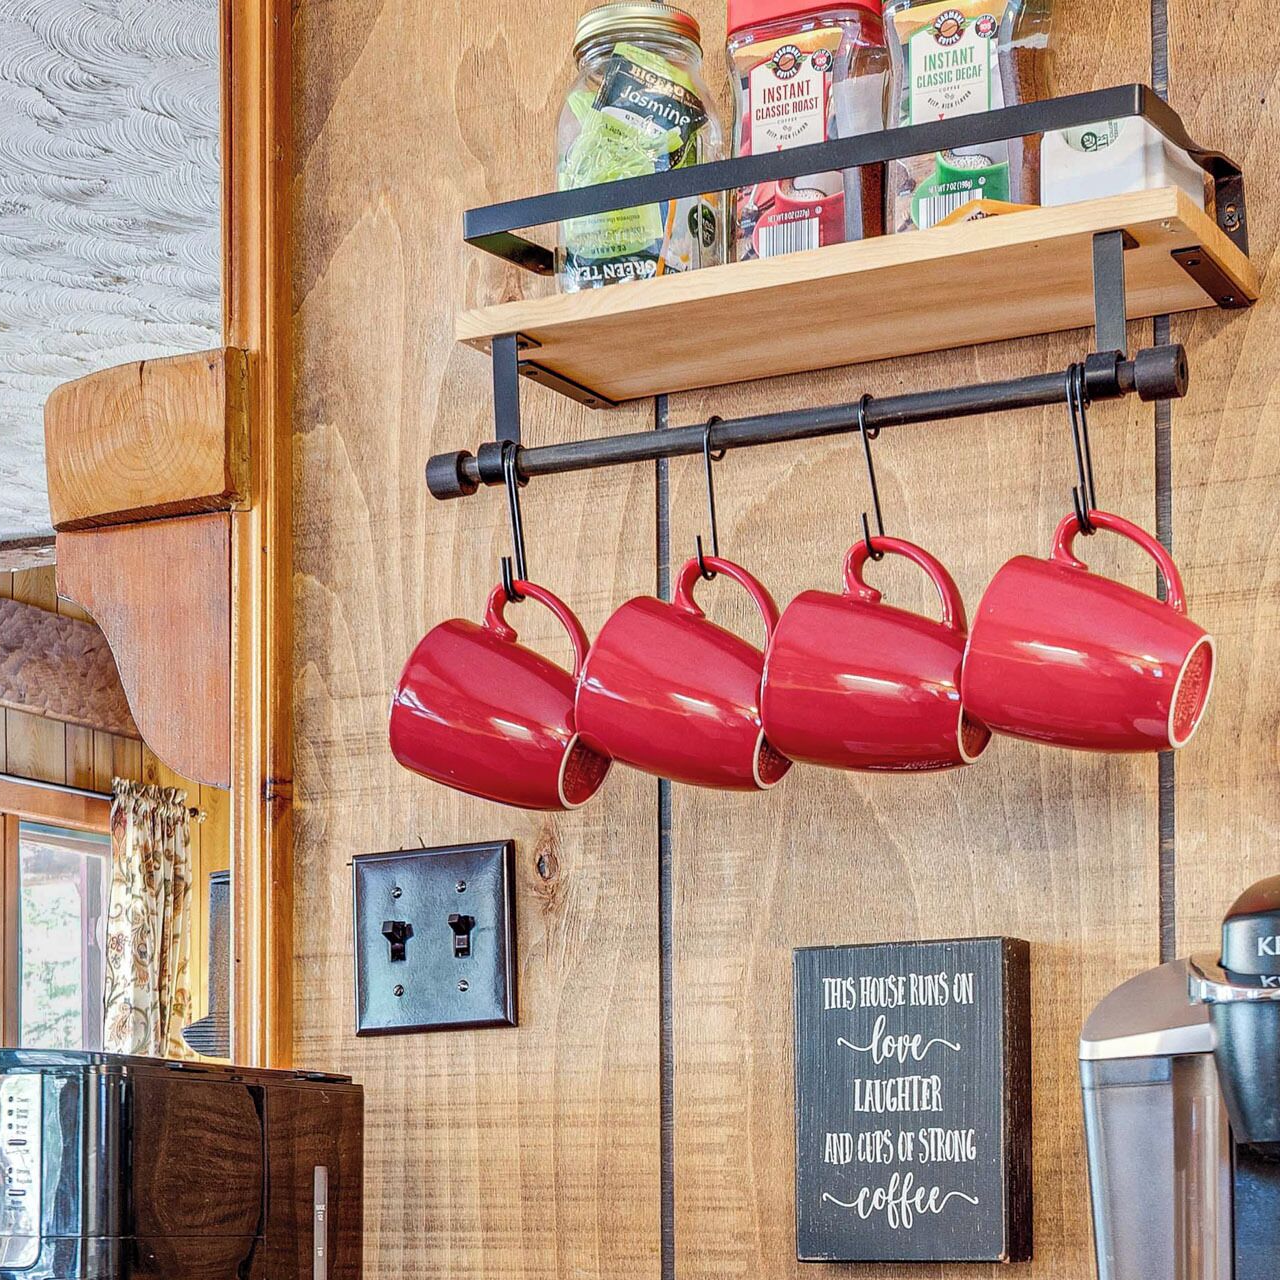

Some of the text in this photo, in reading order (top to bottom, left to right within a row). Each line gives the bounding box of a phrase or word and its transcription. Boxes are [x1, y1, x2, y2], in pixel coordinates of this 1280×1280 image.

[916, 64, 983, 89] CLASSIC DECAF
[924, 46, 975, 73] INSTANT
[620, 85, 691, 126] Jasmine
[755, 97, 819, 121] CLASSIC ROAST
[762, 79, 811, 105] INSTANT
[603, 259, 657, 281] GREEN
[822, 971, 974, 1010] THIS HOUSE RUNS ON
[836, 1014, 961, 1065] love
[853, 1075, 943, 1113] LAUGHTER
[823, 1127, 977, 1164] AND CUPS OF STRONG
[822, 1171, 980, 1229] coffee
